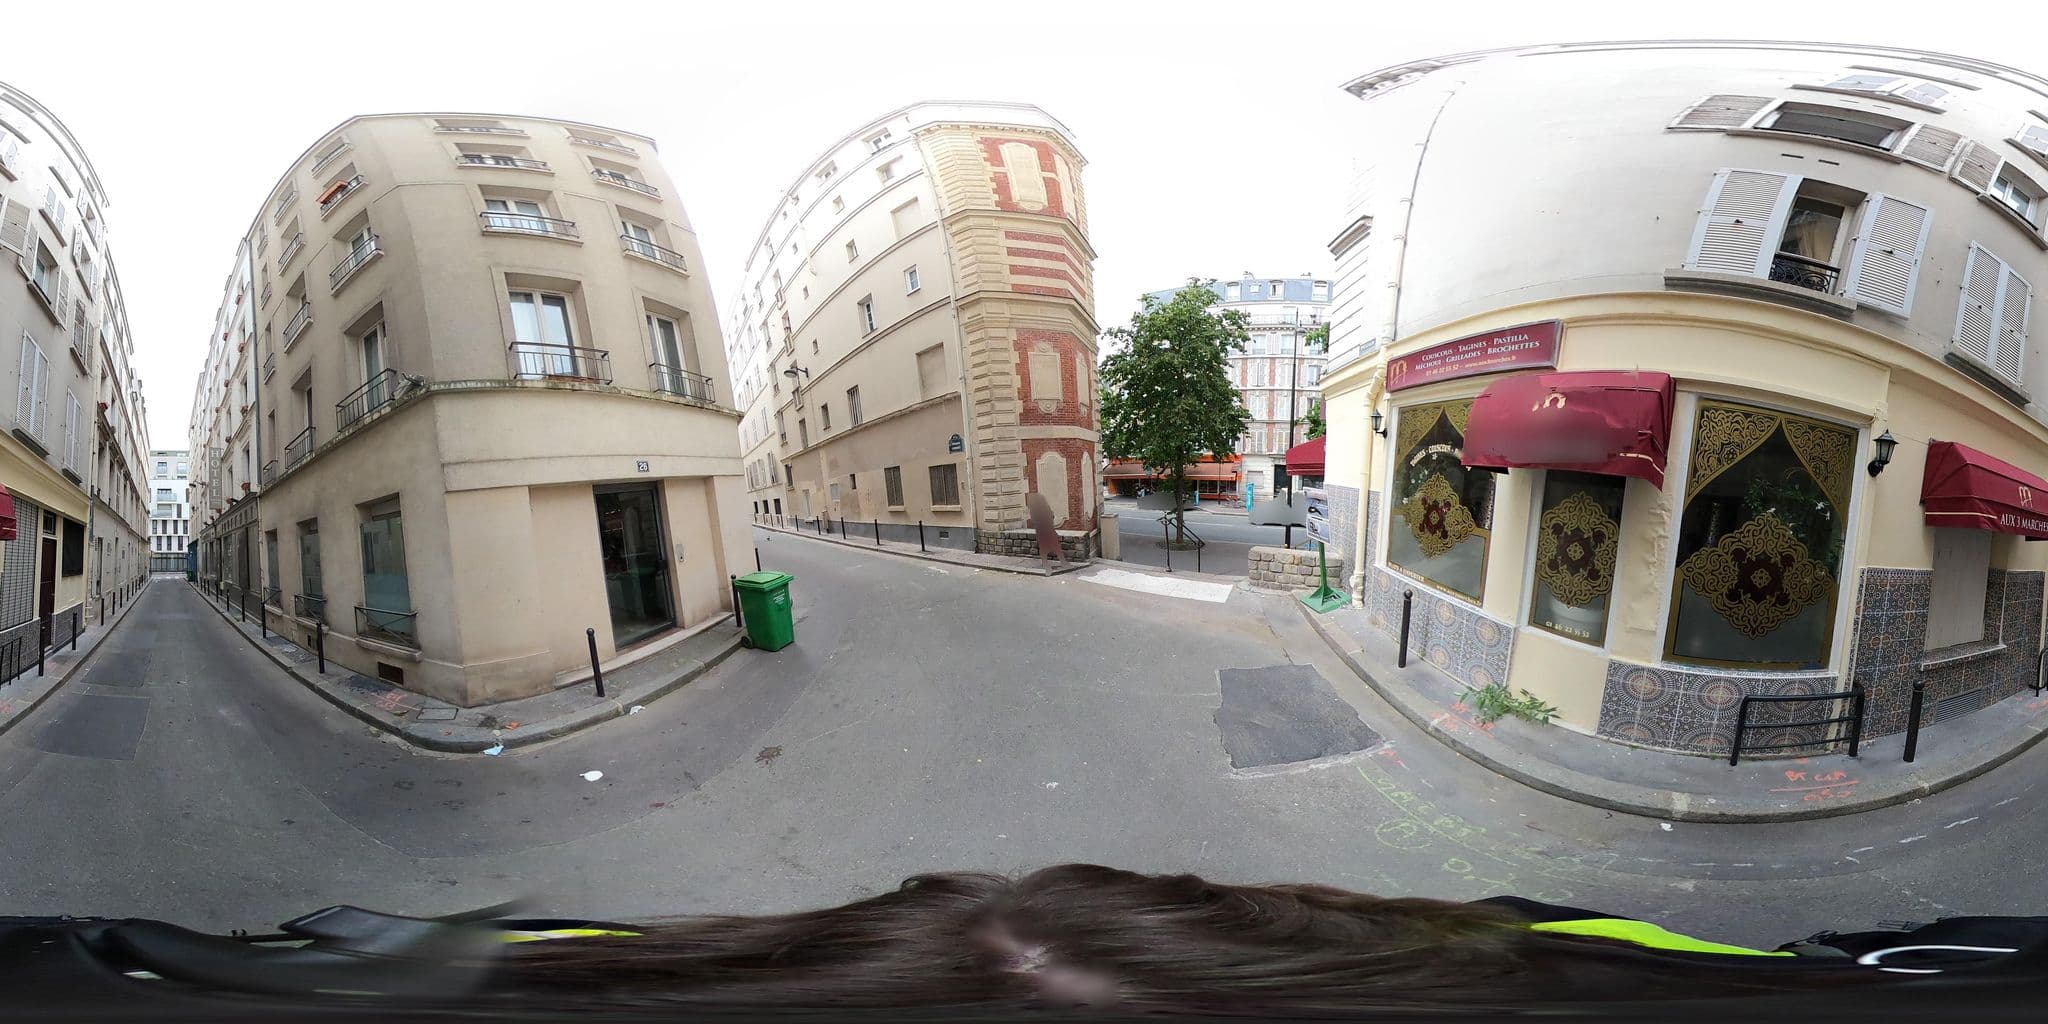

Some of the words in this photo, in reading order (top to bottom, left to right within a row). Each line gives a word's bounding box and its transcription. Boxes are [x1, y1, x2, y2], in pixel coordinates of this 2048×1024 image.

[1422, 349, 1453, 361] COUSCOUS
[1458, 341, 1487, 352] TAGINES
[1493, 334, 1529, 345] PASTILLA
[1446, 350, 1481, 362] GRILLADES
[1487, 341, 1540, 355] BROCHETTES
[210, 450, 220, 497] HOTEL
[2000, 513, 2015, 527] AUX
[2016, 516, 2021, 528] 3
